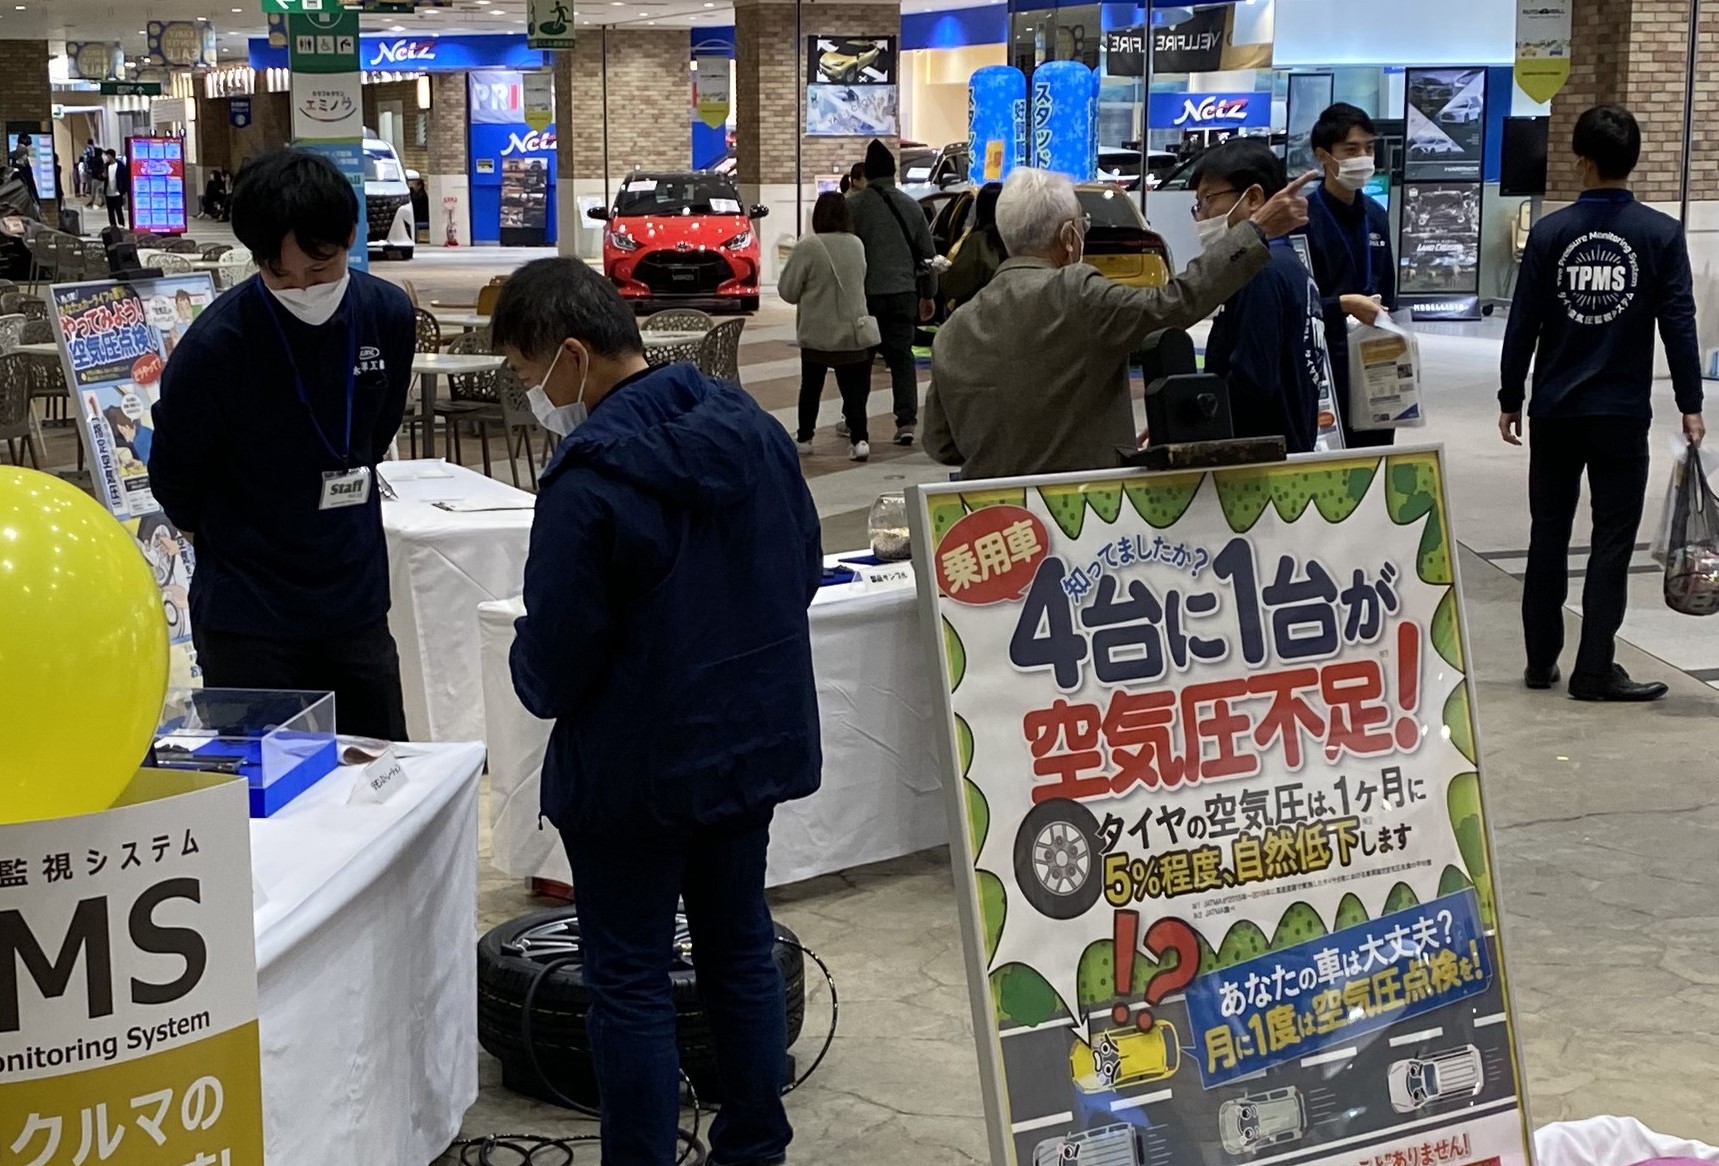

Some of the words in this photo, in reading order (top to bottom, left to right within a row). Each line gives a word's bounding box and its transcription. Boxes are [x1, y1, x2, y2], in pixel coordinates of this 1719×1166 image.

[370, 39, 436, 65] Netz
[1174, 96, 1248, 125] Netz
[1566, 266, 1626, 291] TPMS
[60, 298, 144, 339] やってみよう!
[69, 325, 158, 369] 空気圧点検!
[330, 480, 364, 495] Staff
[942, 520, 1042, 594] 乗用車
[1063, 535, 1209, 602] 知ってましたか?
[1011, 538, 1399, 689] 4台に1台が
[1024, 622, 1419, 804] 空気圧不足!
[1099, 770, 1427, 855] タイヤの空気圧は、1ヶ月に
[0, 828, 200, 889] 監視システム
[1104, 815, 1413, 904] 5%程度、自然低下します
[1220, 910, 1453, 1017] あなたの車は大丈夫?
[1204, 940, 1484, 1073] 月に1度は空気圧点検を!
[0, 1030, 118, 1073] nitoring
[126, 1010, 211, 1052] System
[10, 1075, 224, 1166] クルマの
